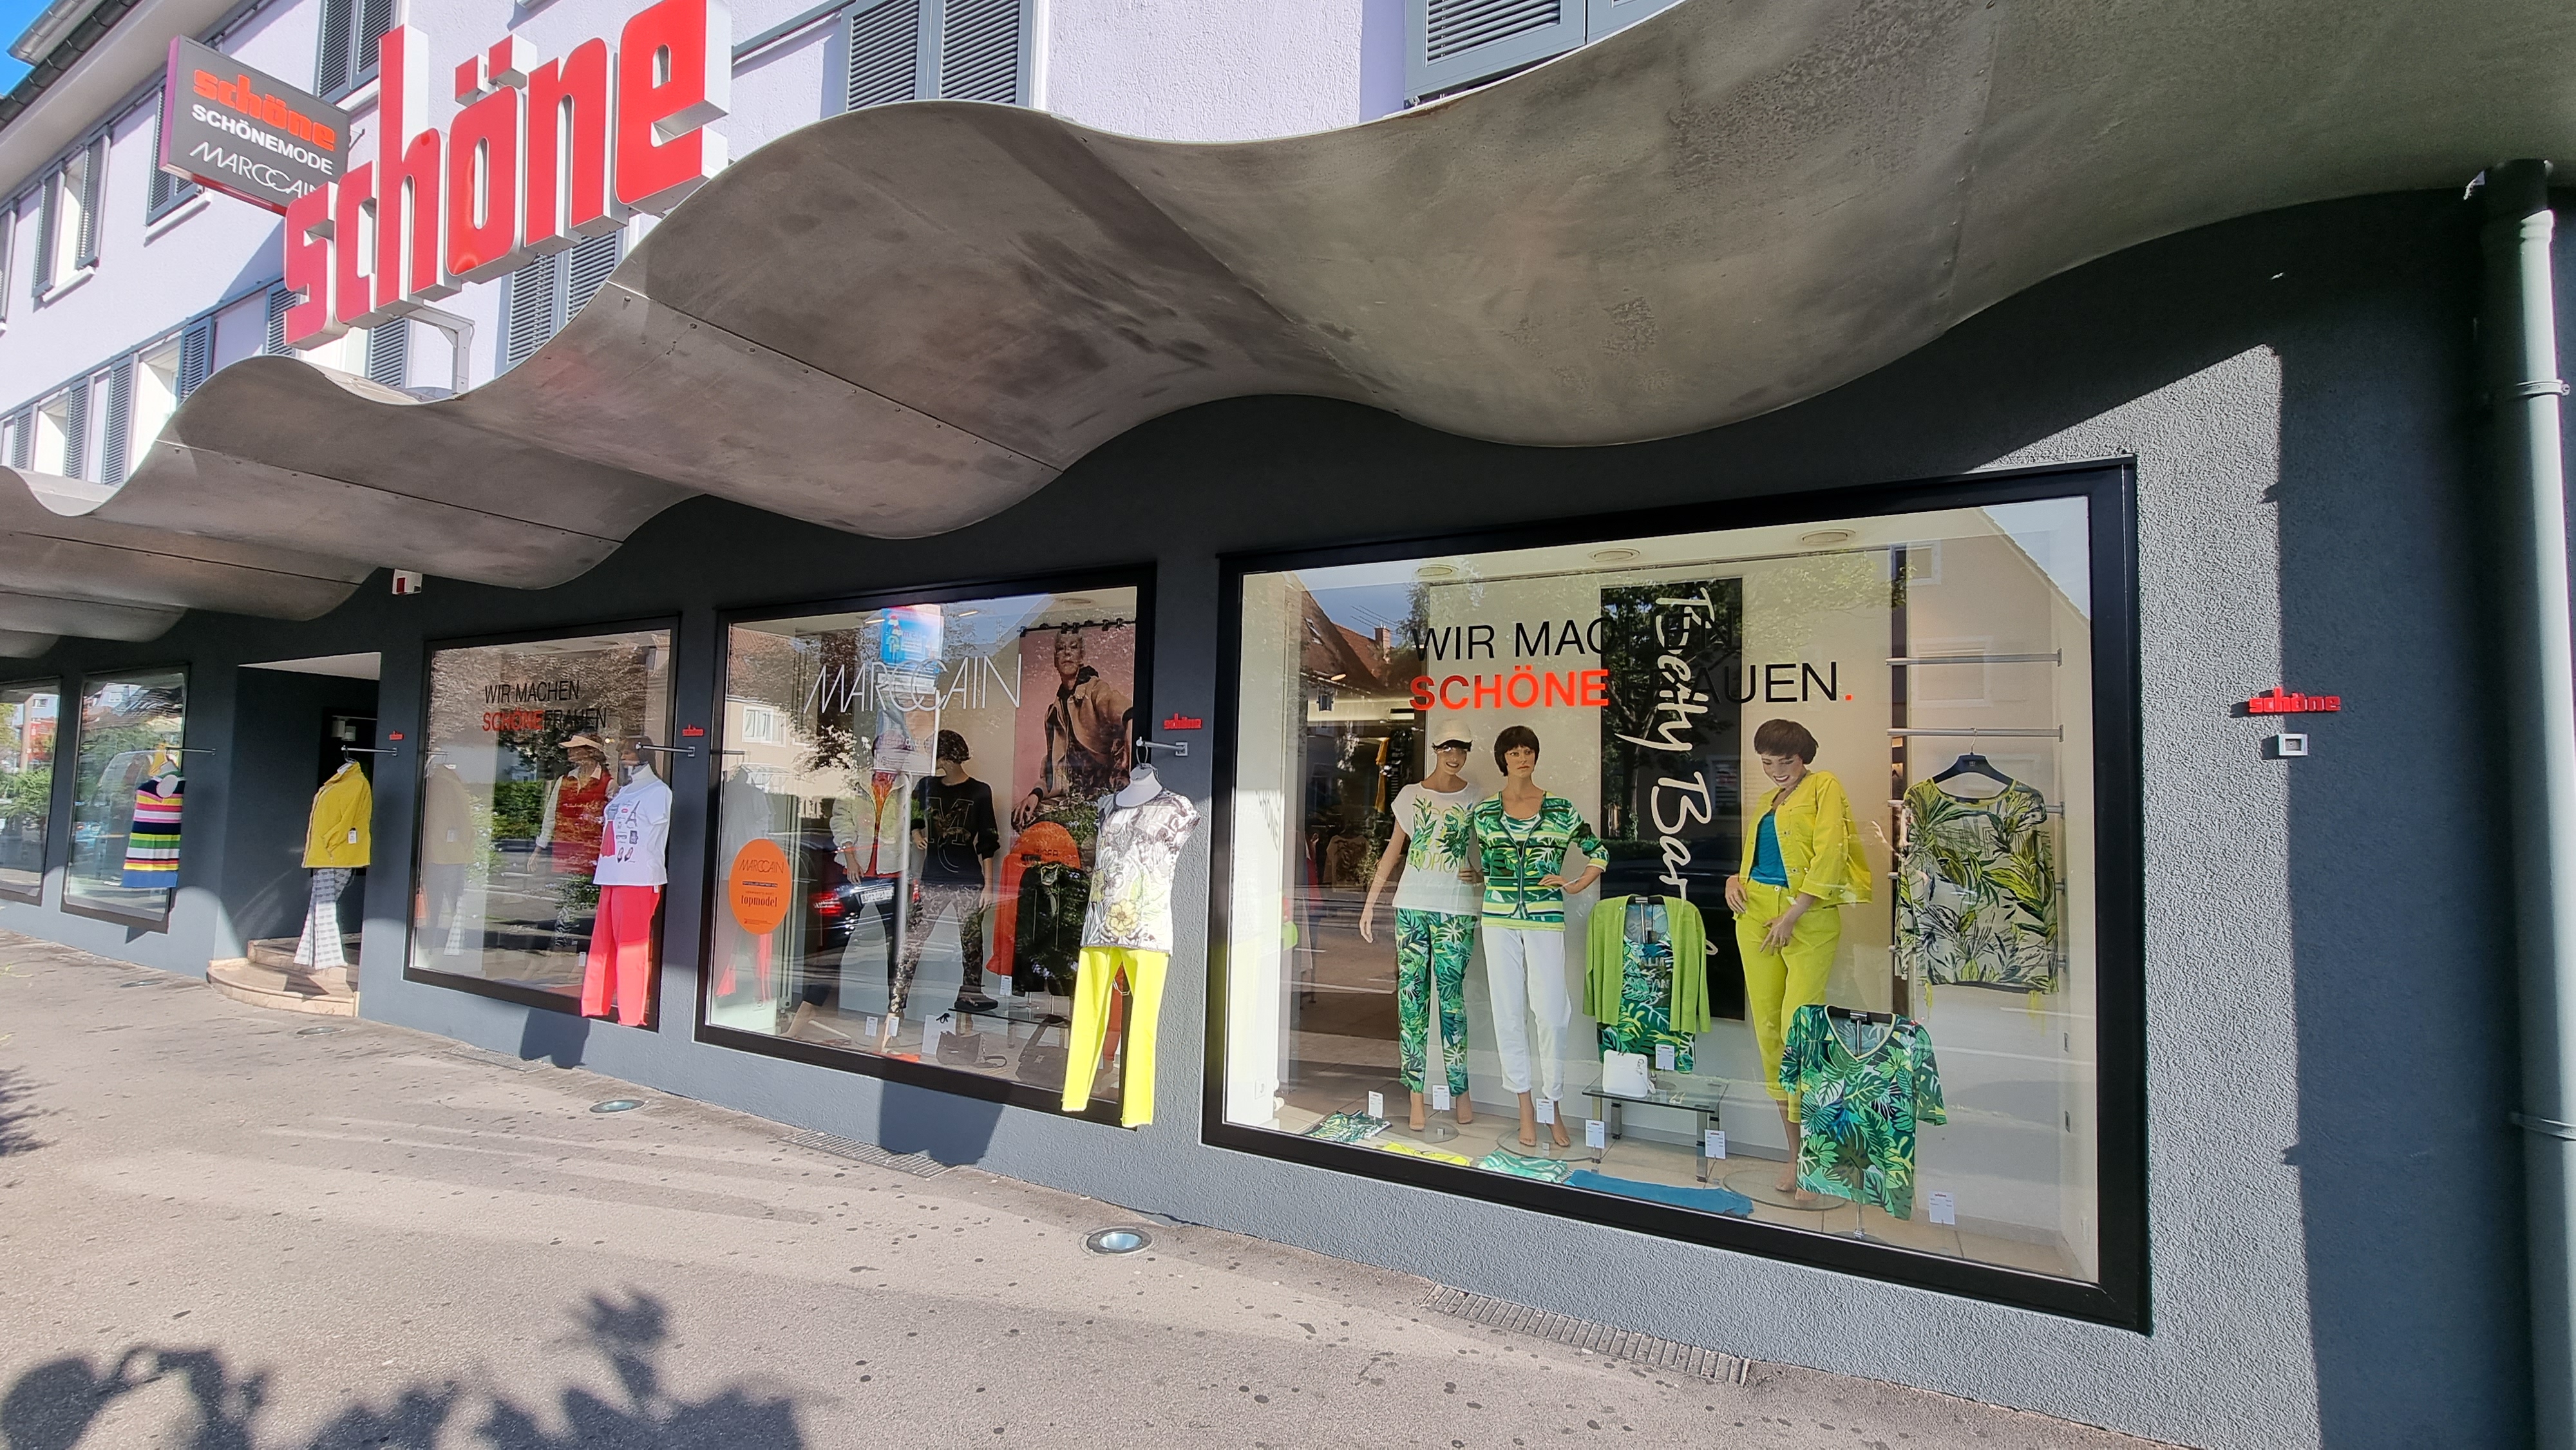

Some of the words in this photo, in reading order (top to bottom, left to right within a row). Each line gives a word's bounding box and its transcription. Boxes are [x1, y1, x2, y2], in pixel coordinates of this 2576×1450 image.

[193, 69, 336, 152] schöne
[191, 104, 333, 176] SCHÖNEMODE
[284, 0, 730, 350] schöne
[1412, 624, 1495, 661] WIR
[1515, 609, 1733, 658] MACHEN
[484, 684, 511, 704] WIR
[515, 680, 580, 702] MACHEN
[1409, 664, 1609, 711] SCHÖNE
[2249, 686, 2342, 714] schöne
[482, 708, 544, 731] SCHÖNE
[741, 894, 778, 907] topmodel
